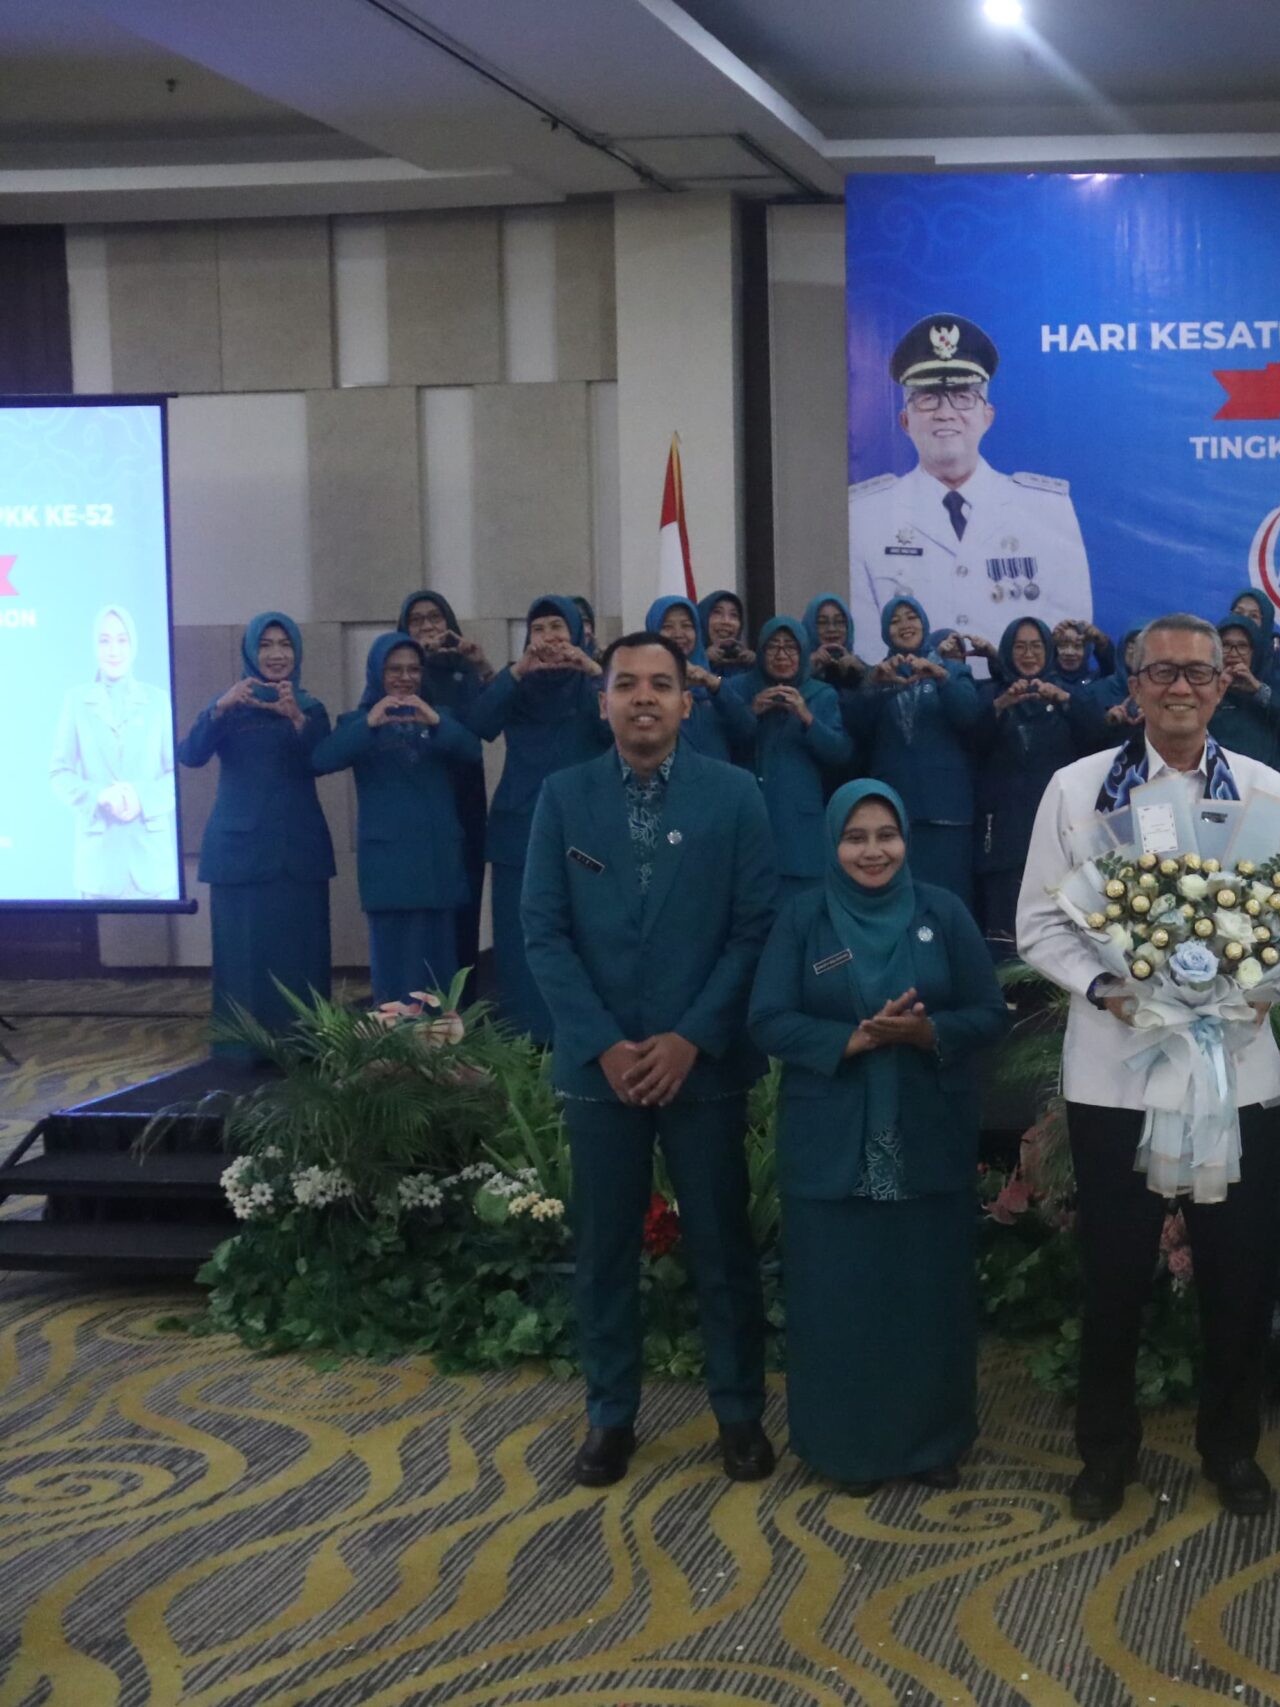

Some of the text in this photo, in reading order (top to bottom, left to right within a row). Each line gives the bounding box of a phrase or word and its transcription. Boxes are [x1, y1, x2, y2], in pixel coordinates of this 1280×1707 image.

[1041, 323, 1138, 353] HARI
[0, 503, 114, 528] KK KE-52
